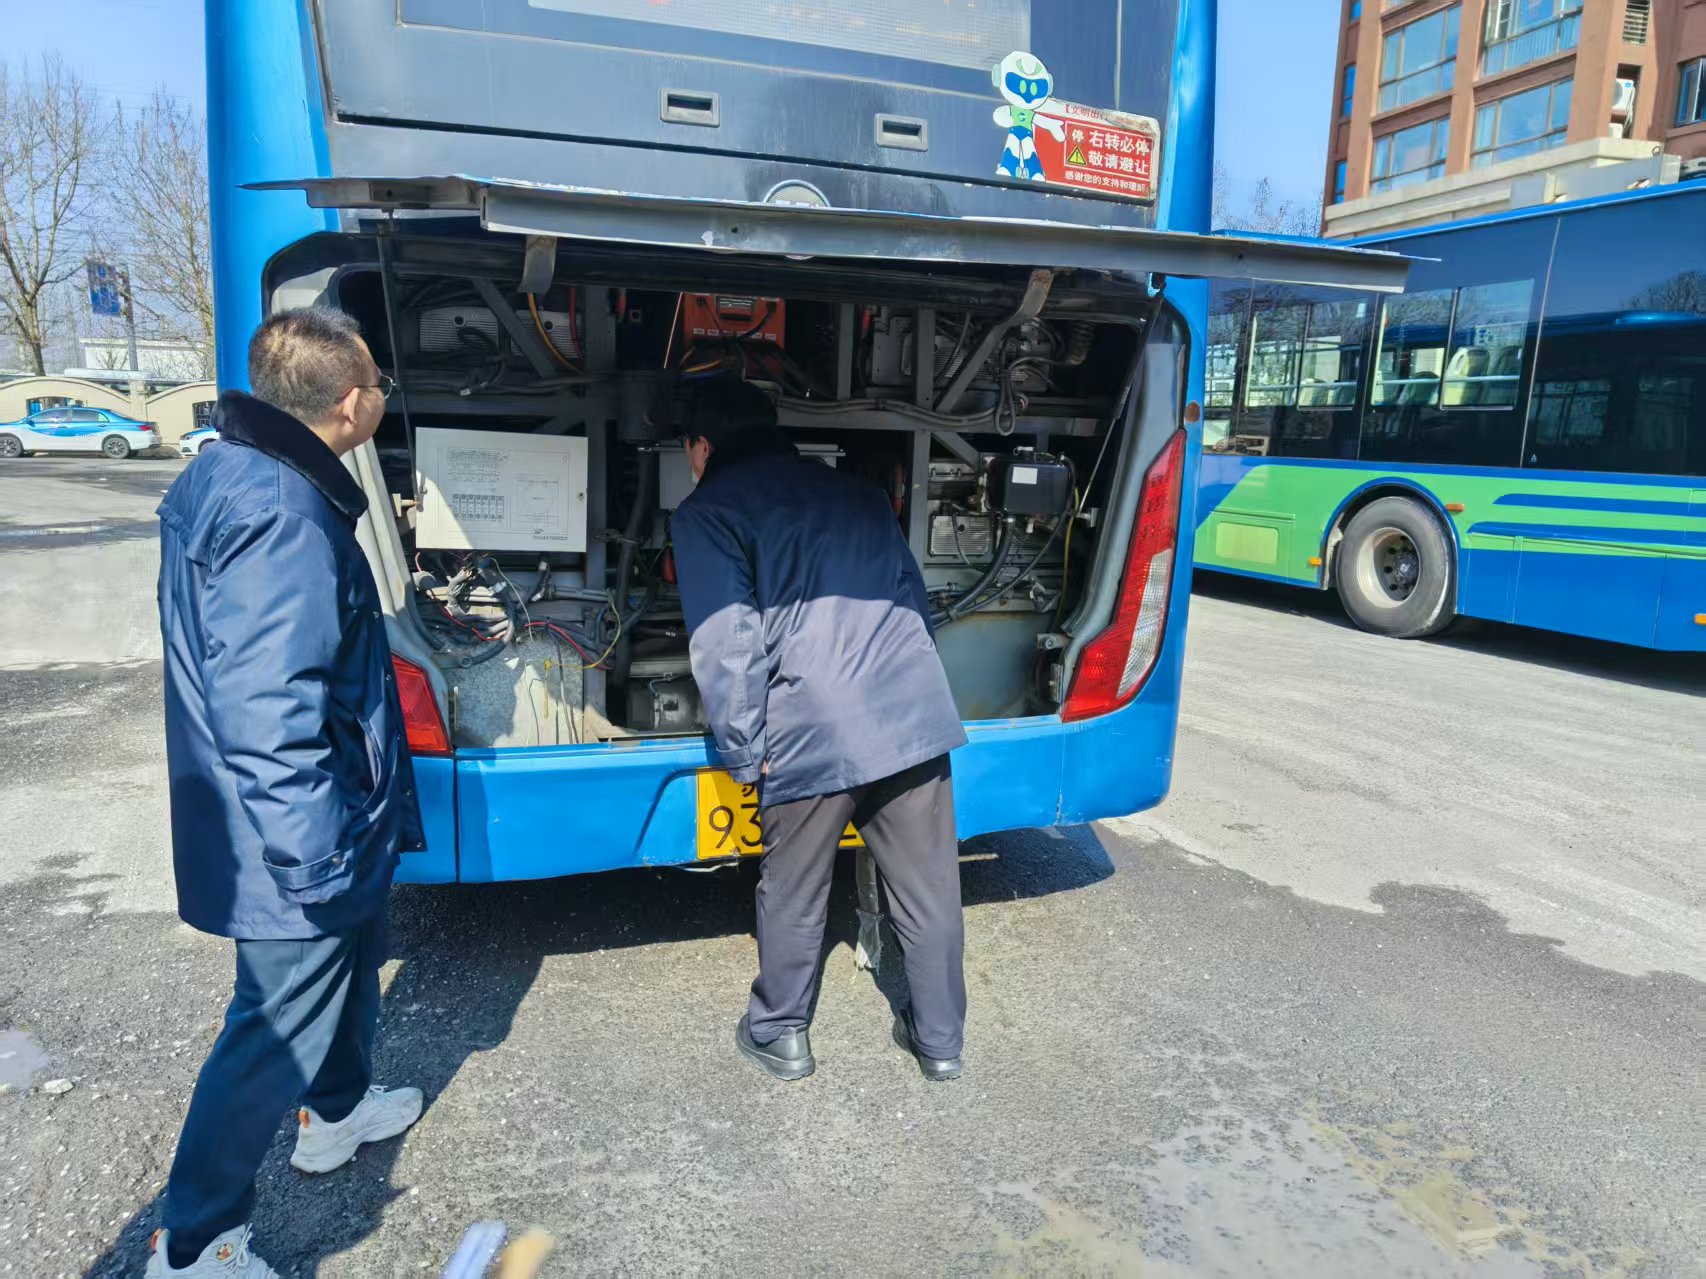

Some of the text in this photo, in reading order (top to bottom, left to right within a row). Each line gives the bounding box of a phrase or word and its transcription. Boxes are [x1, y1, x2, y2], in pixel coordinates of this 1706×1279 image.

[1071, 129, 1084, 143] 停
[1089, 130, 1150, 156] 右转必停
[1088, 150, 1149, 174] 敬请避让
